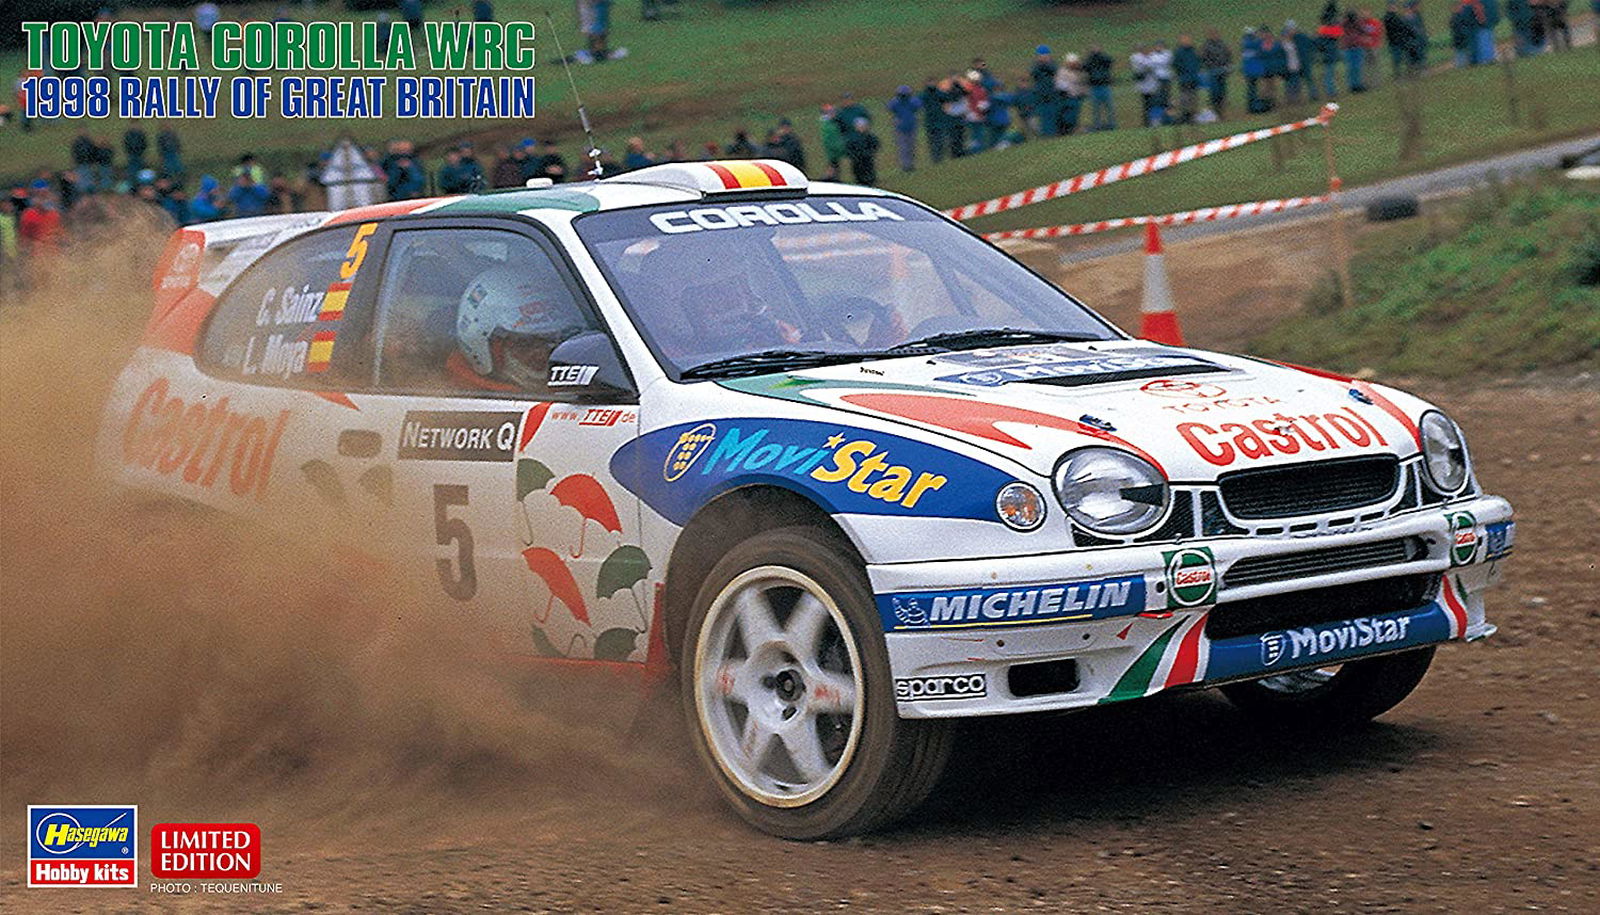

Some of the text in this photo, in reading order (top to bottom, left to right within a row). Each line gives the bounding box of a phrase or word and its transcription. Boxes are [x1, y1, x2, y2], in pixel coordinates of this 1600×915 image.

[650, 201, 905, 234] COROLLA
[340, 222, 378, 279] 5
[275, 283, 325, 326] Sainz
[122, 377, 291, 498] Castrol
[496, 421, 516, 451] Q
[1176, 406, 1388, 466] Castrol
[701, 427, 948, 508] MoviStar
[433, 483, 478, 601] 5
[930, 581, 1132, 621] MICHELIN
[1287, 616, 1411, 659] MoviStar
[897, 675, 985, 698] sparco
